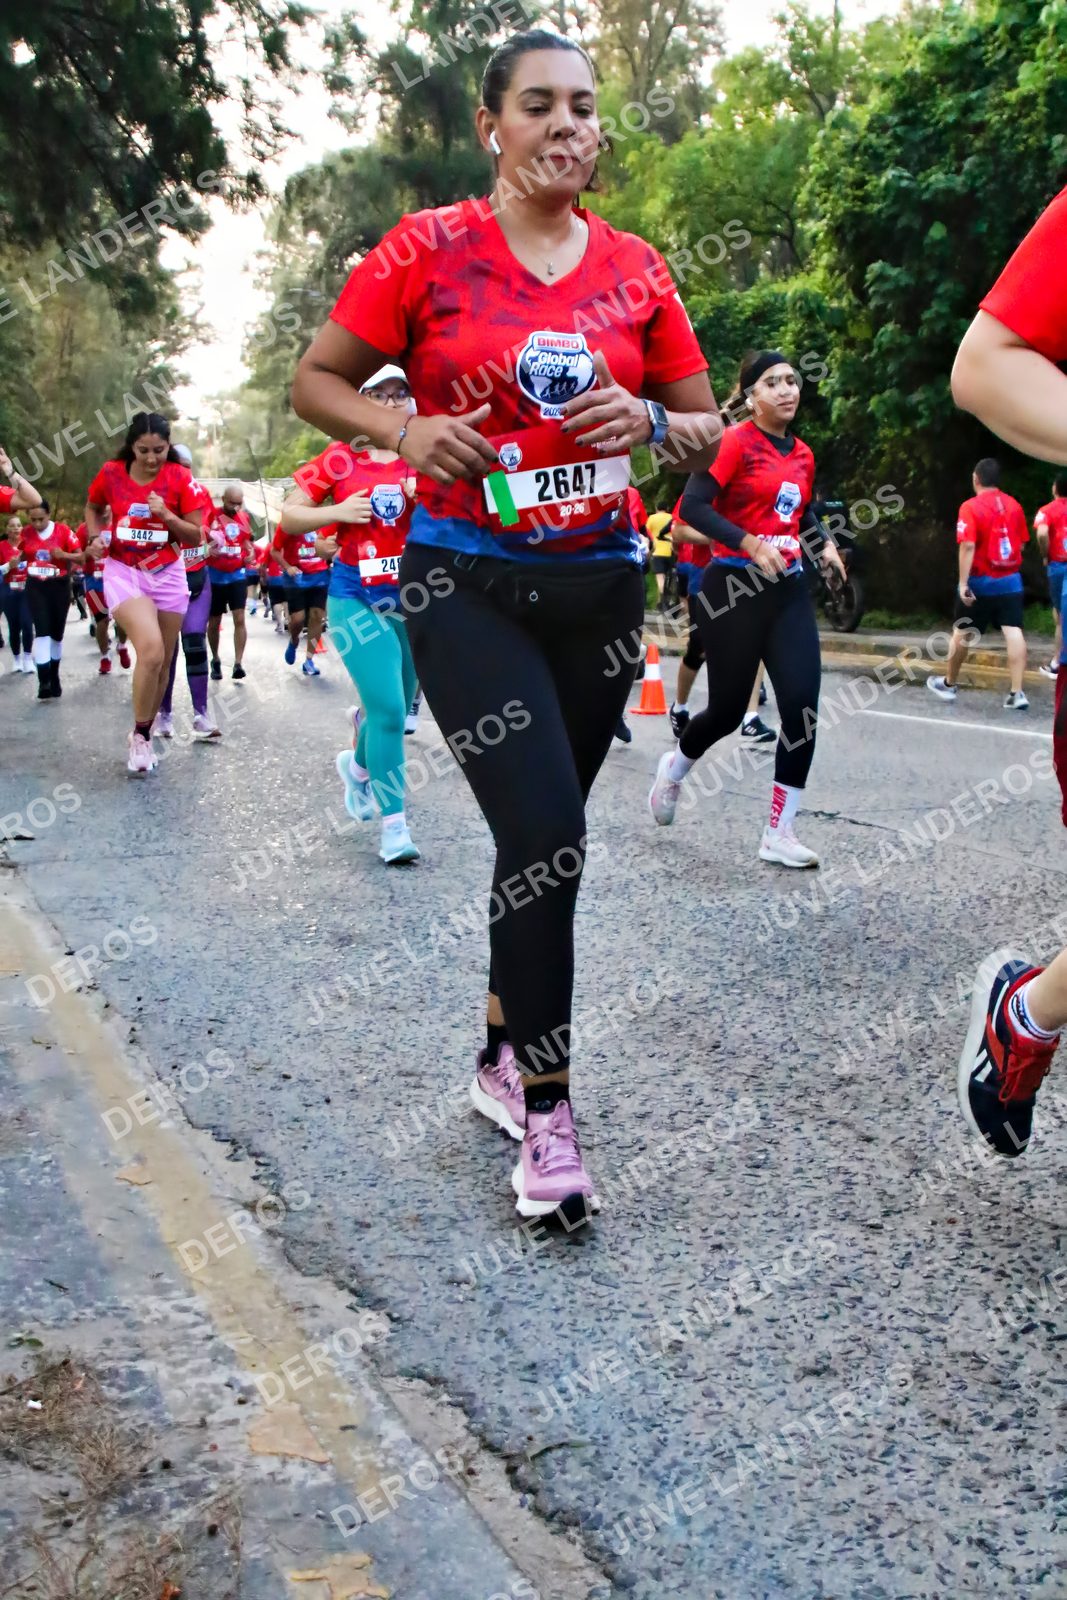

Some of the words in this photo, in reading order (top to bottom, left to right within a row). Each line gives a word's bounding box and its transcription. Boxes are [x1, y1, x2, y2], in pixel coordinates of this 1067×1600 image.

[537, 337, 579, 349] BIMBO
[537, 351, 578, 367] Global
[529, 362, 563, 377] Race
[535, 463, 596, 502] 2647
[131, 529, 153, 541] 3442
